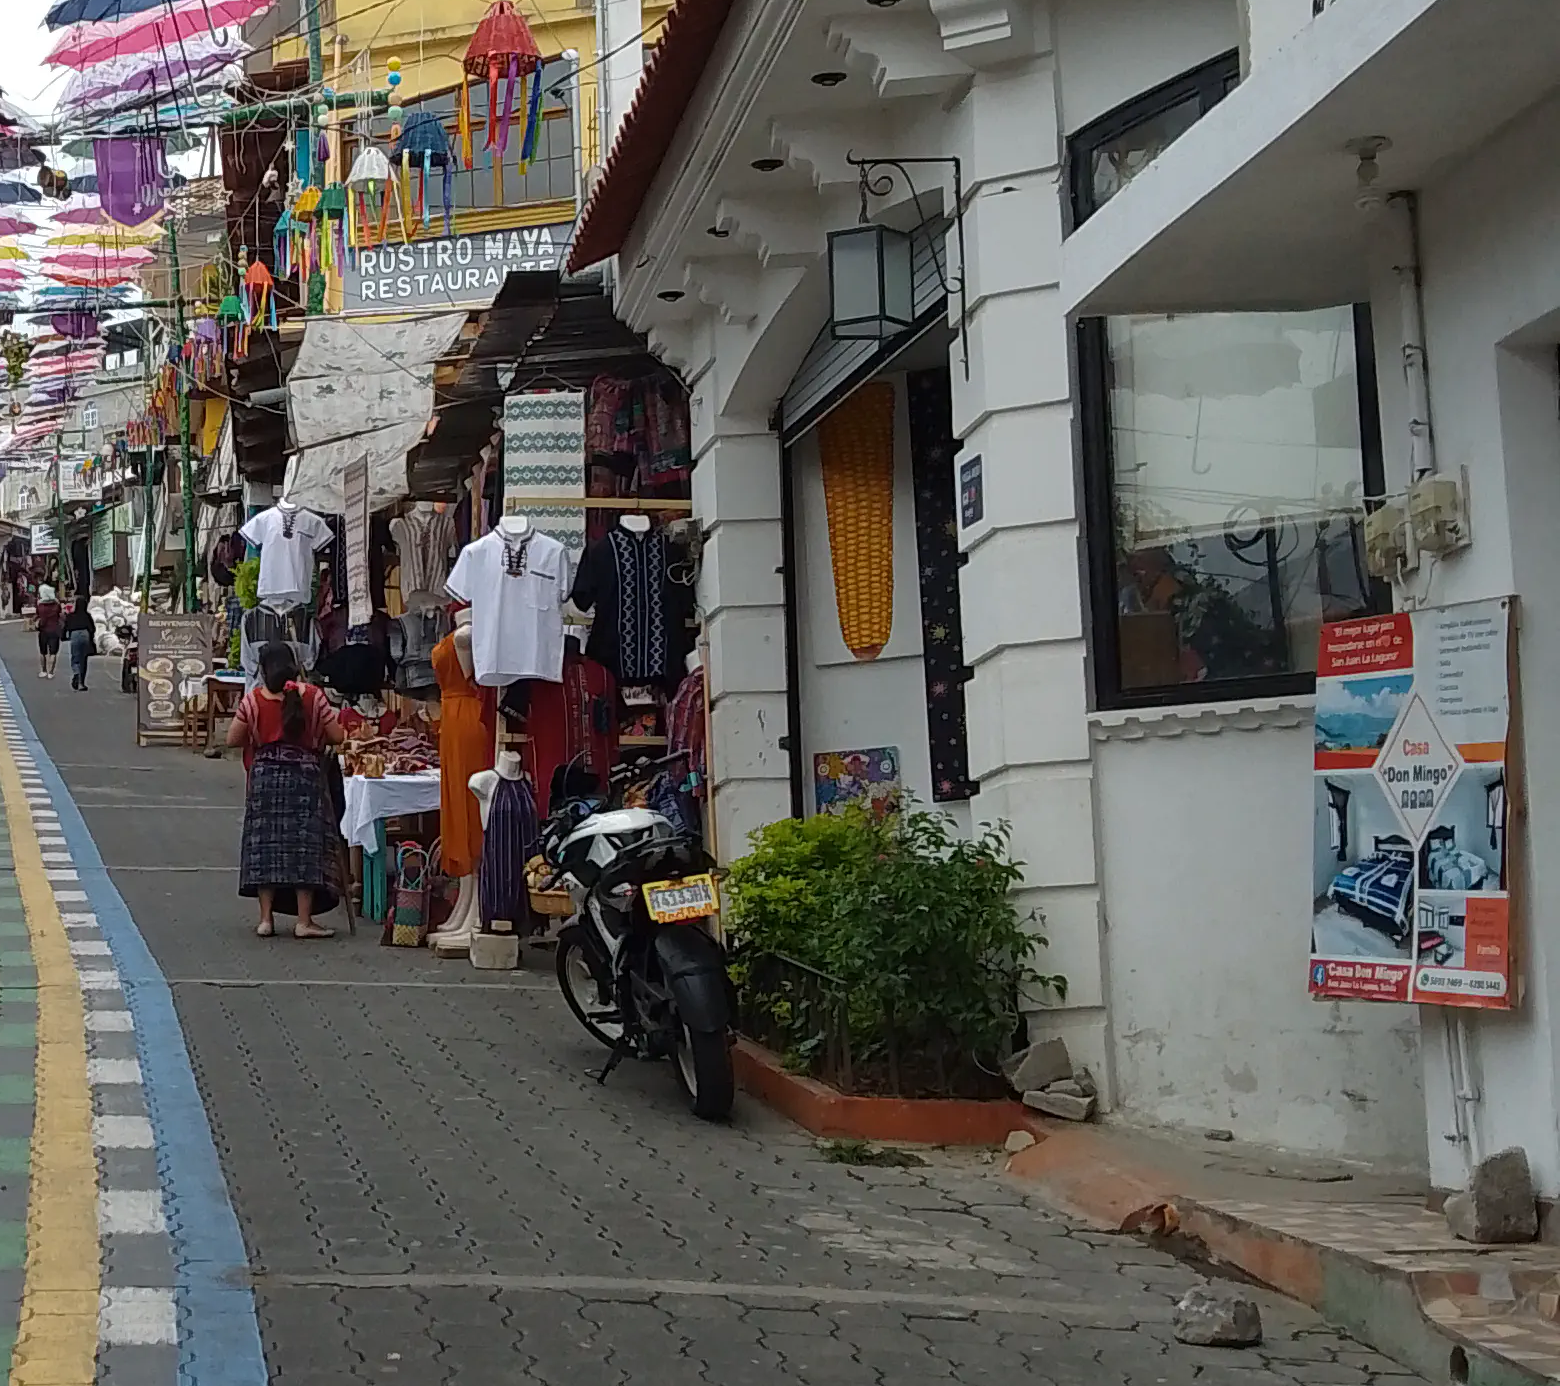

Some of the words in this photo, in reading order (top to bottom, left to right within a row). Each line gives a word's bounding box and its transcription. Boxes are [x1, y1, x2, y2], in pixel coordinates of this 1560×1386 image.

[360, 238, 473, 276] ROSTRO
[485, 227, 555, 262] MAYA
[1402, 739, 1430, 756] Casa
[1412, 765, 1453, 785] Mingo"
[1355, 964, 1372, 978] Don
